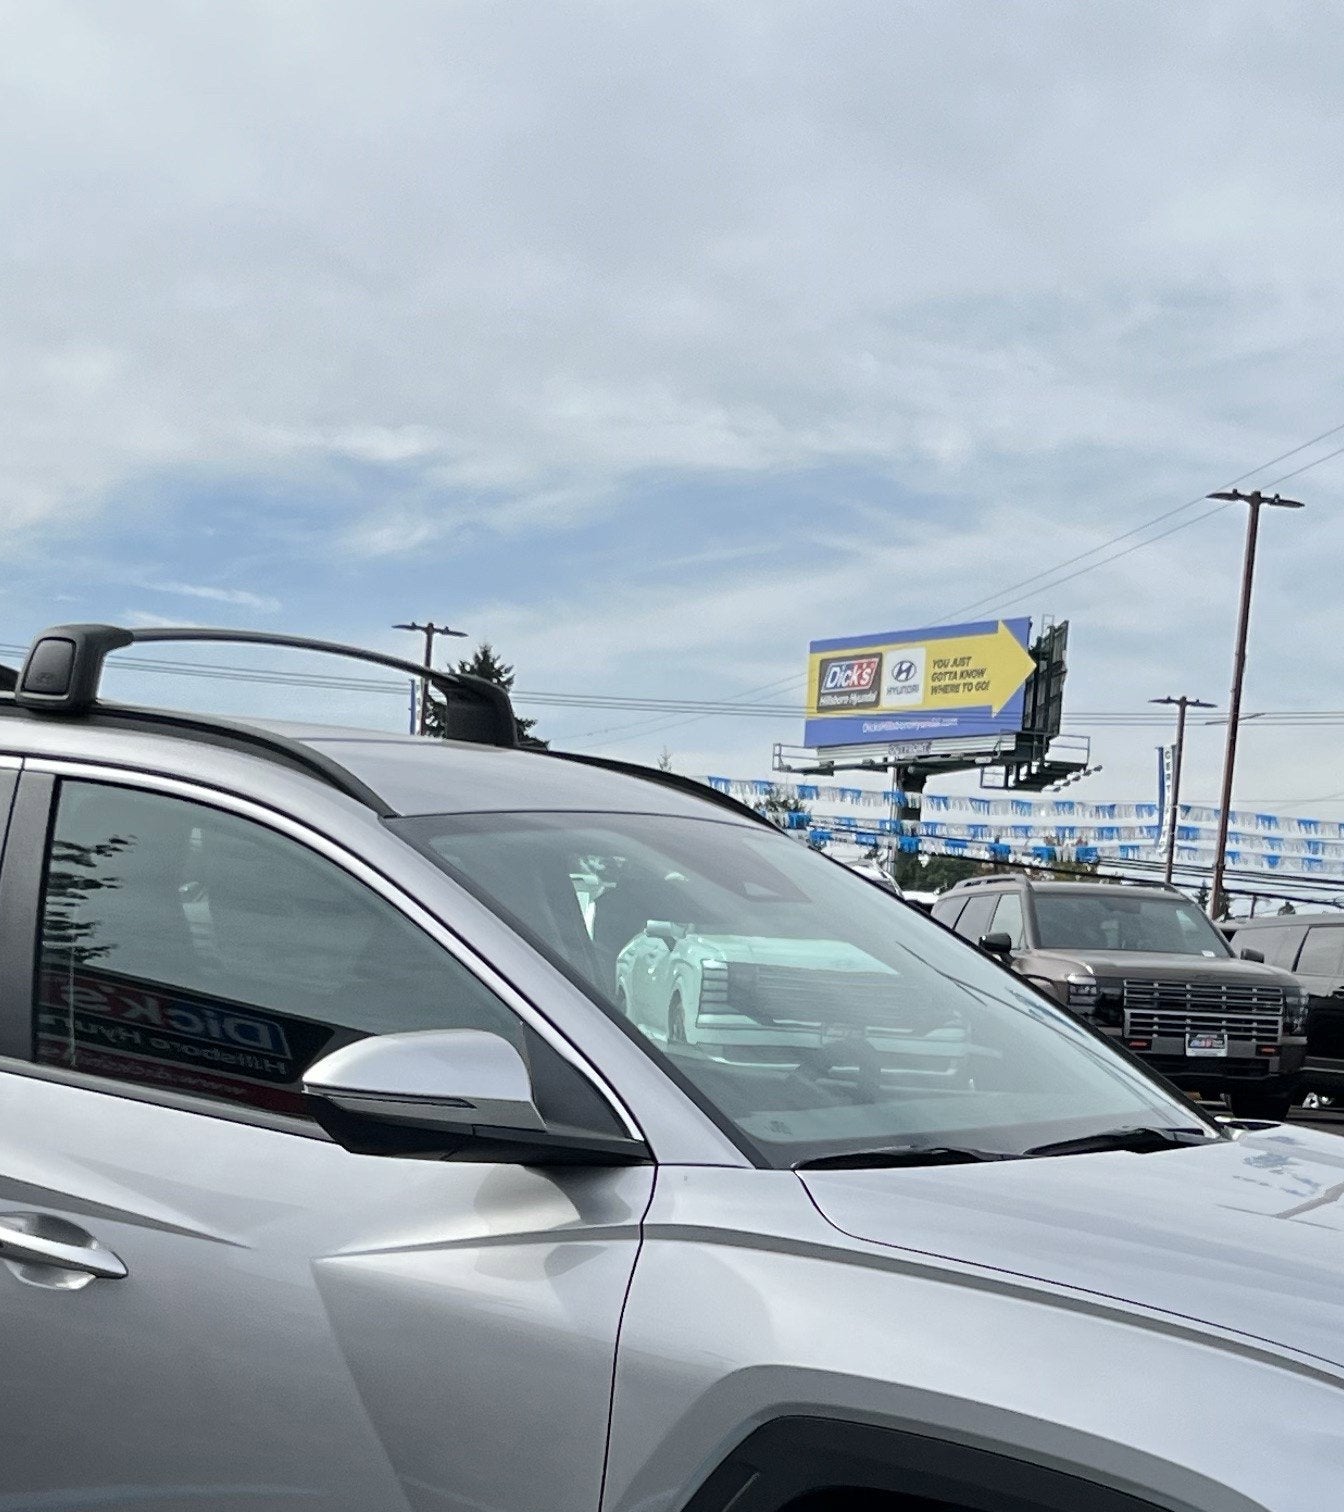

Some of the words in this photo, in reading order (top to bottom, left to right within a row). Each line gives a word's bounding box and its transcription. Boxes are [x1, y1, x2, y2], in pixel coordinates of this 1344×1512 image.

[933, 659, 951, 669] YOU
[950, 656, 972, 668] JUST
[826, 663, 872, 688] Dick's
[931, 670, 958, 682] GOTTA
[959, 667, 987, 680] KNOW
[886, 684, 920, 696] HYUNDAI
[930, 683, 961, 695] WHERE
[961, 682, 974, 692] TO
[974, 679, 991, 692] GO!
